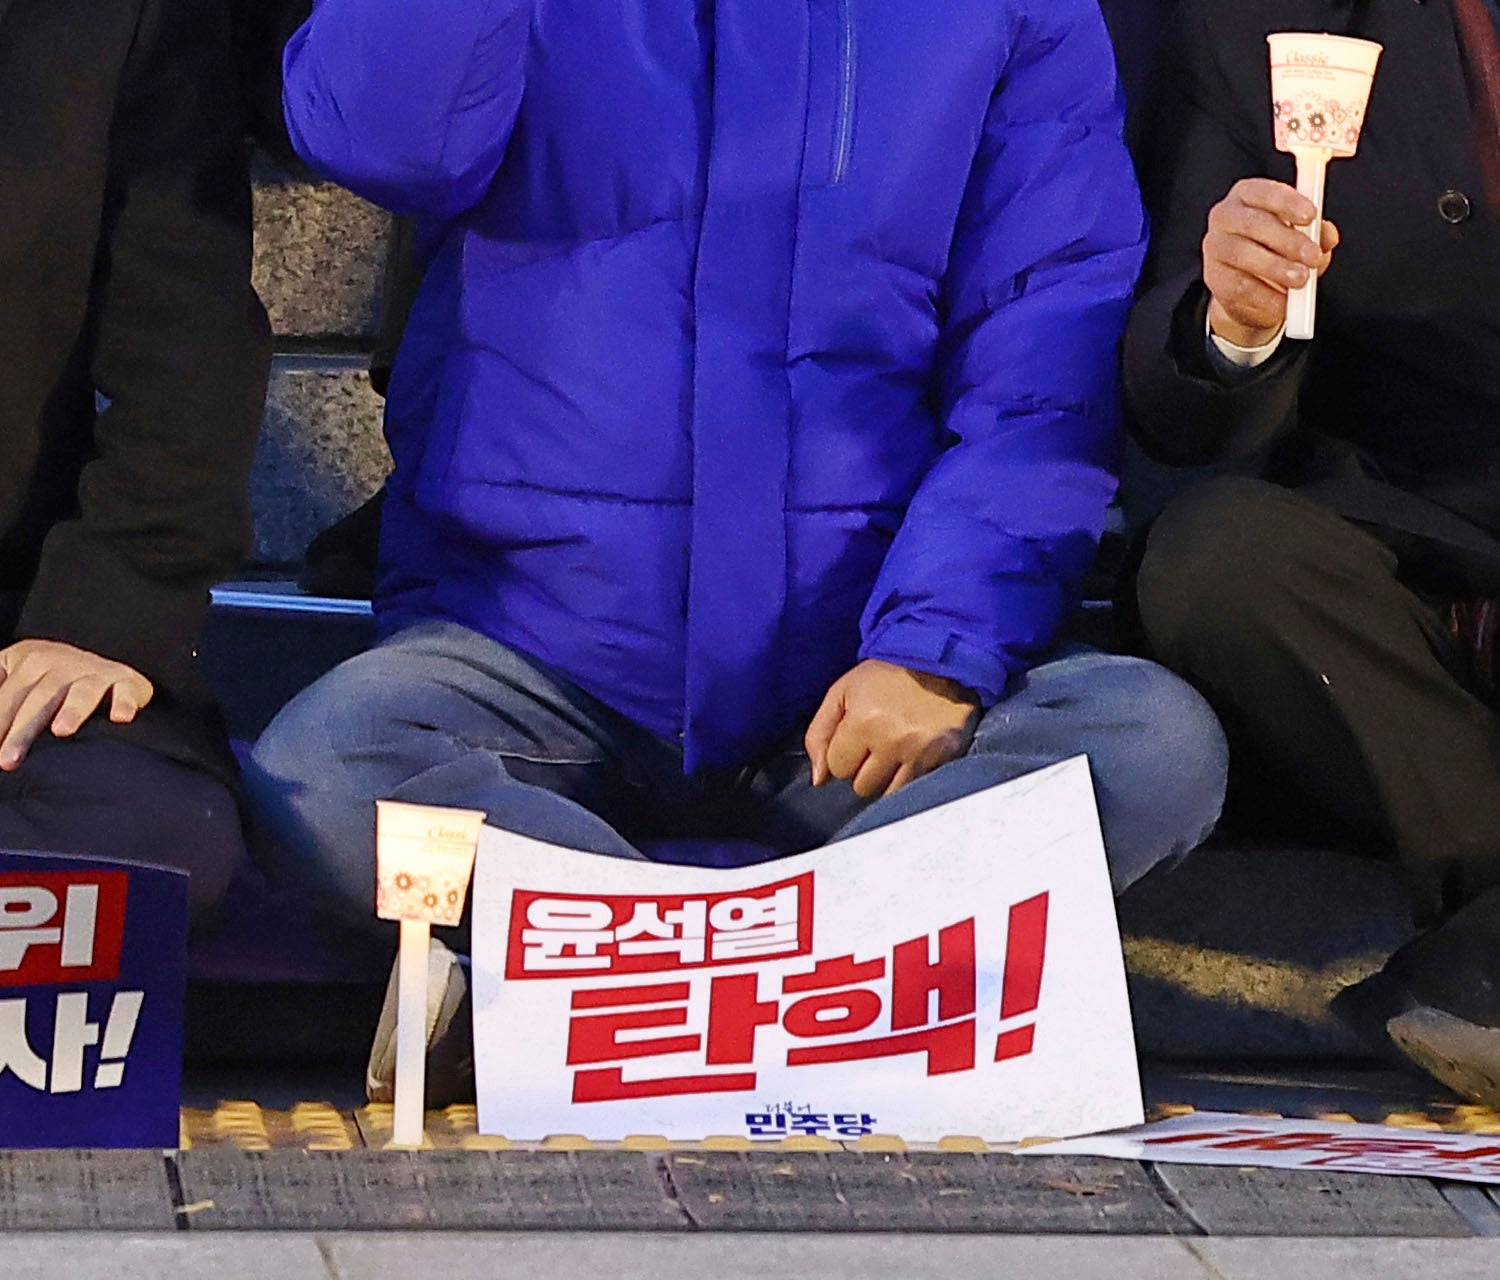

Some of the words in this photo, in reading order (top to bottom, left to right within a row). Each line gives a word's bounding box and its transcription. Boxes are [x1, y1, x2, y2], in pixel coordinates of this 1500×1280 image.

[523, 886, 798, 971] 윤석열
[567, 891, 1048, 1103] 탄핵!
[745, 1113, 877, 1141] 민주당
